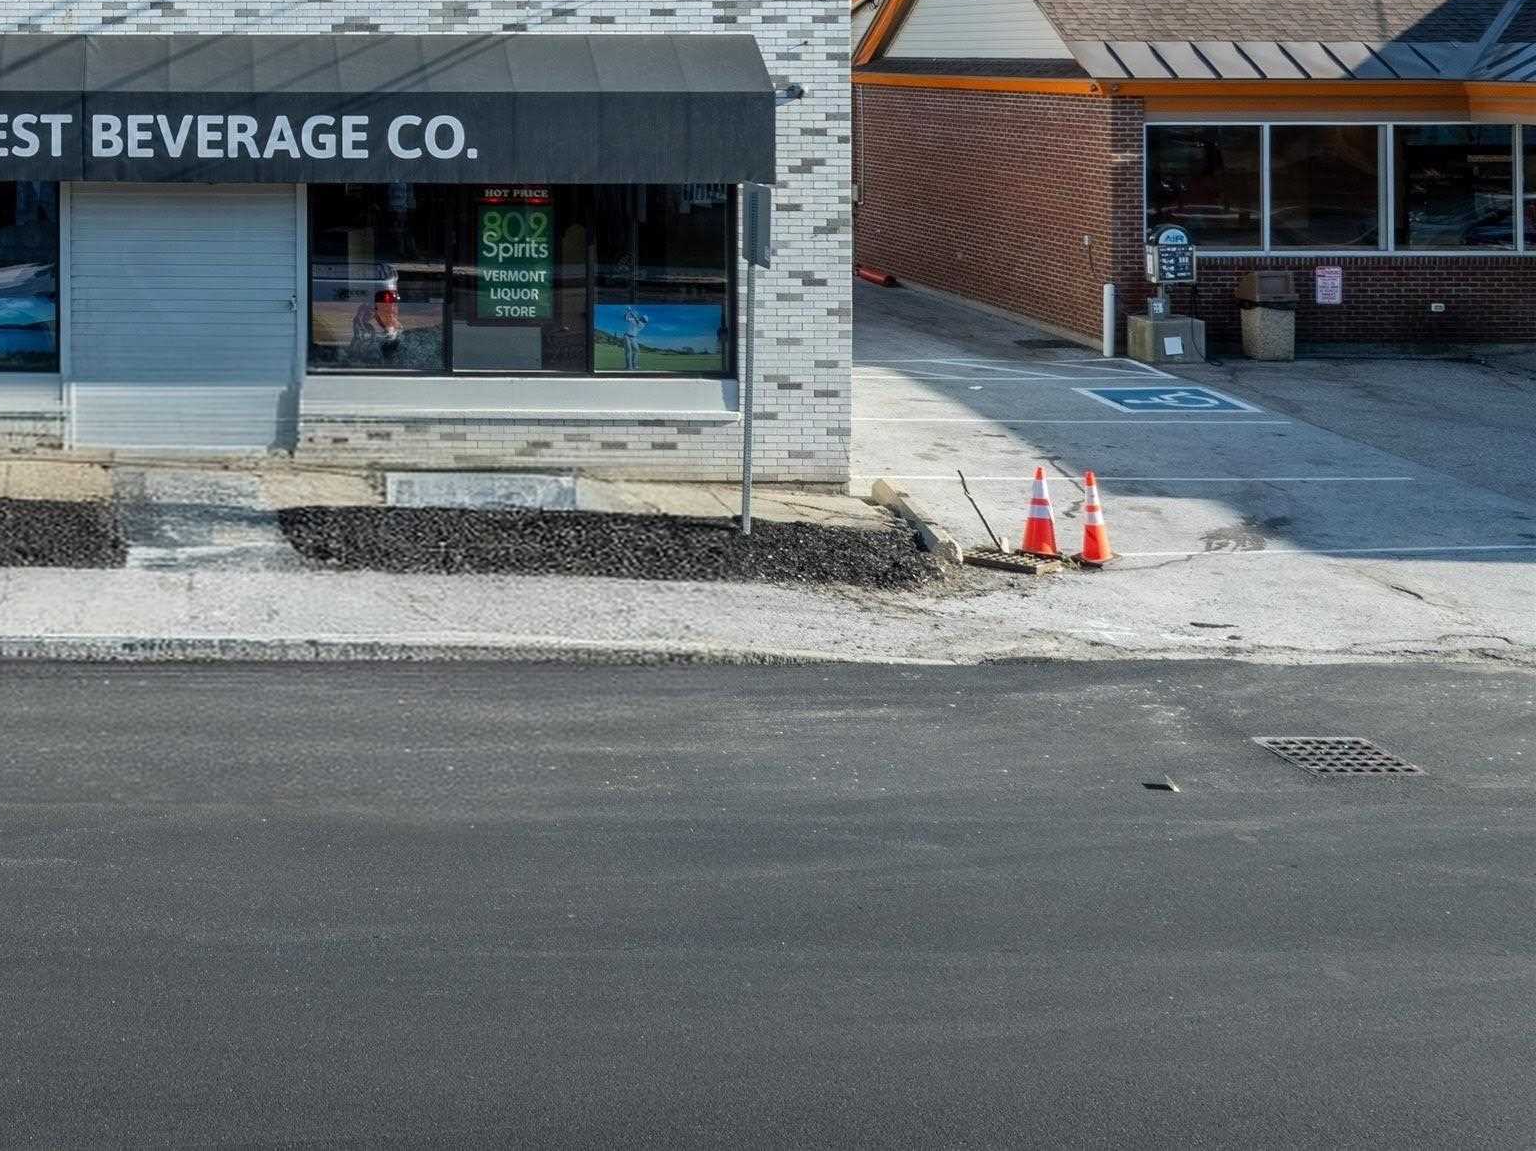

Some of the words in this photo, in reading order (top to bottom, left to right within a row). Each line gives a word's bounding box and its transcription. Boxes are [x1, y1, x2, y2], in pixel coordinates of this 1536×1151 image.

[91, 113, 370, 160] BEVERAGE
[386, 114, 479, 160] CO.
[484, 188, 511, 197] HOT
[511, 188, 550, 197] PRICE
[482, 211, 548, 243] 802
[482, 231, 549, 262] Spirits
[483, 270, 547, 282] VERMONT
[489, 288, 540, 301] LIQUOR
[495, 305, 537, 317] STORE
